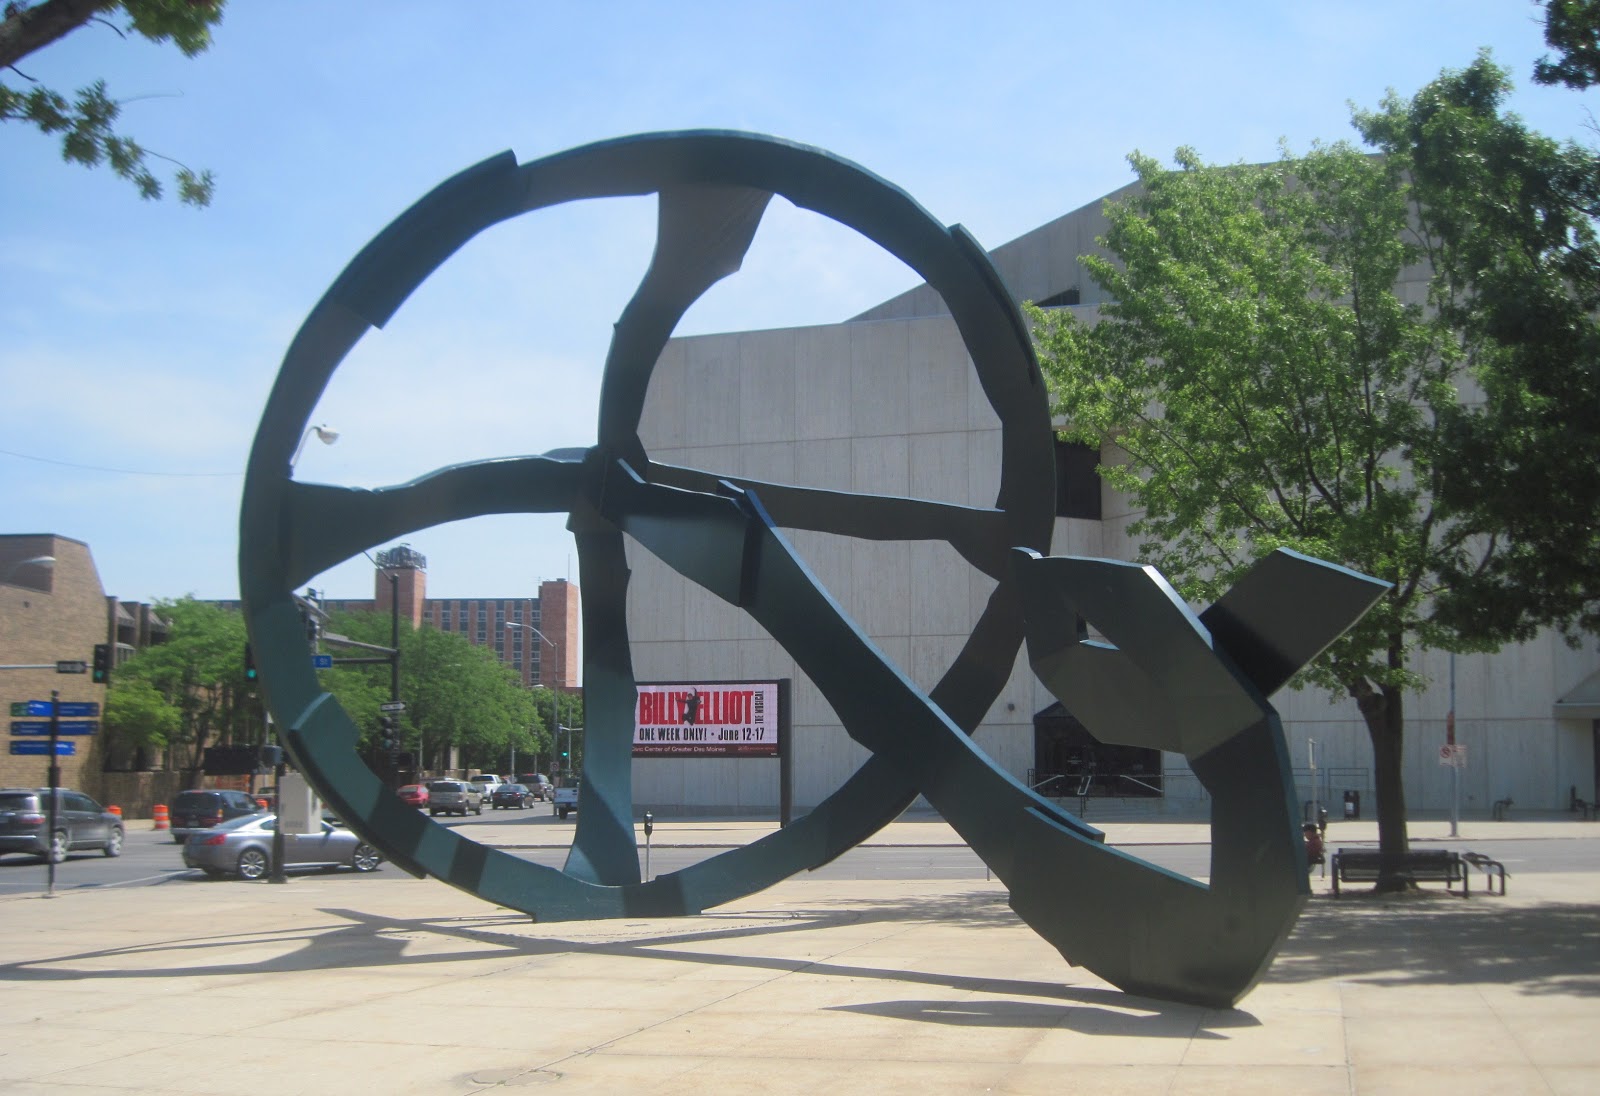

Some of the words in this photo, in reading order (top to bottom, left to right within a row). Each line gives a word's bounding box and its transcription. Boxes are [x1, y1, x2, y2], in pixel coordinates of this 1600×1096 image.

[639, 691, 688, 725] BILLY
[694, 691, 753, 725] ELLIOT
[754, 690, 764, 714] MUSICAL
[754, 715, 764, 724] THE
[639, 728, 655, 741] ONE
[658, 728, 680, 741] WEEK
[683, 727, 707, 741] ONLY!
[718, 727, 739, 741] June
[742, 727, 765, 741] 12-17
